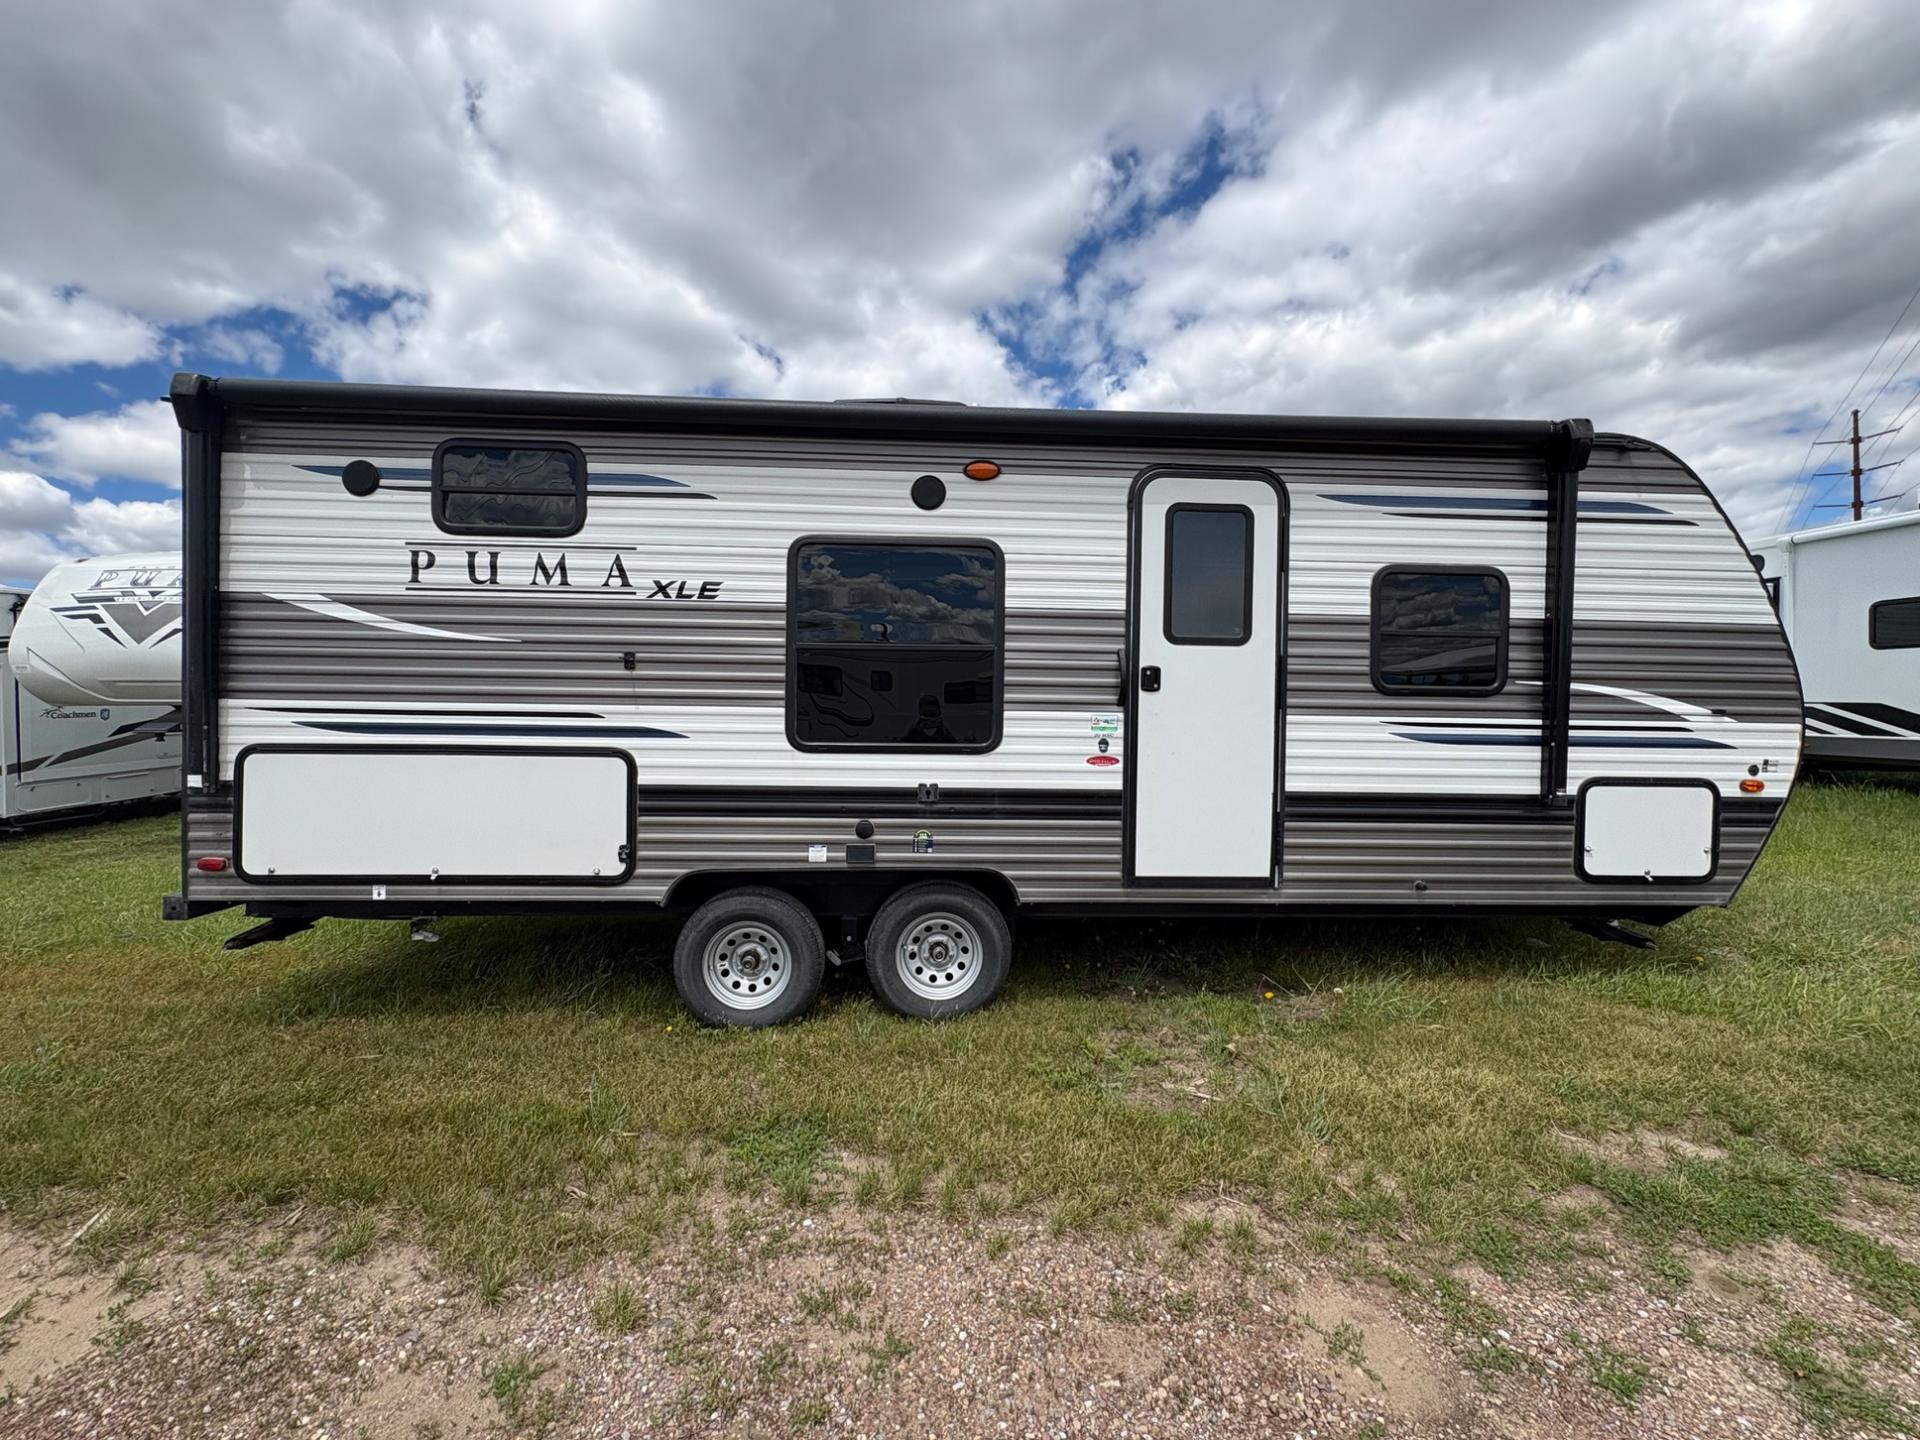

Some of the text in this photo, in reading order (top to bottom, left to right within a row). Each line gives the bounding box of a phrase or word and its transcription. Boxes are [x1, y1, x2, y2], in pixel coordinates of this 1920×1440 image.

[408, 549, 724, 600] PUMA XLE
[51, 709, 96, 720] Coachmen
